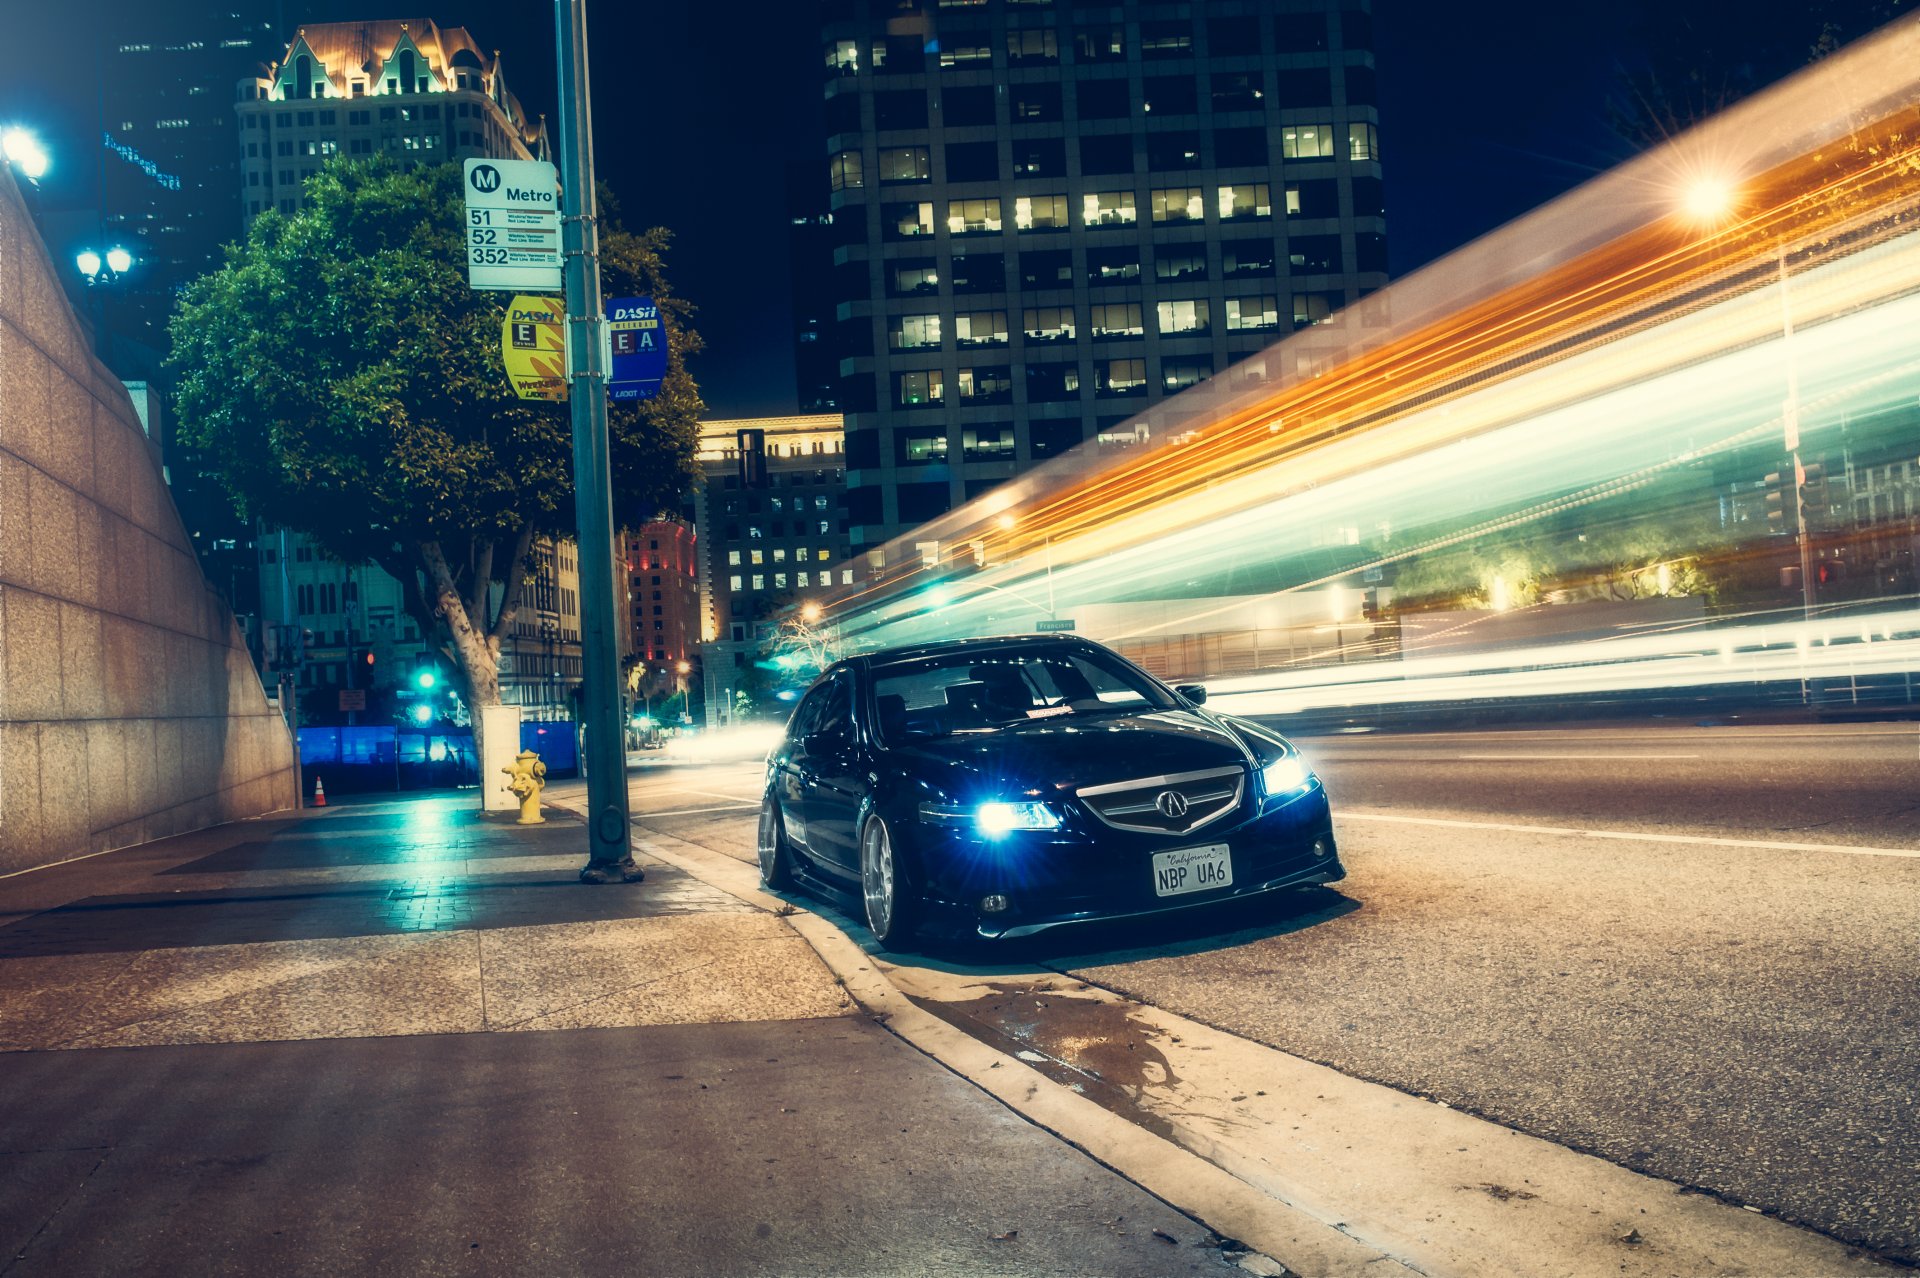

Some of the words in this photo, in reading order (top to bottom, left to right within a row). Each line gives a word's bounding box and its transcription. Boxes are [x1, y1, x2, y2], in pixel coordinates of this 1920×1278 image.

[476, 170, 496, 188] M
[507, 188, 552, 202] Metro
[471, 210, 490, 225] 51
[472, 230, 497, 244] 52
[473, 248, 508, 264] 352
[512, 309, 554, 322] DASH
[614, 307, 656, 320] DASH
[615, 321, 653, 329] WEEKDAY
[518, 324, 530, 341] E
[618, 334, 628, 350] E
[640, 331, 653, 348] A
[615, 390, 638, 398] LADOT
[1170, 853, 1215, 865] California
[1159, 867, 1187, 890] NBP
[1197, 861, 1225, 883] UA6
